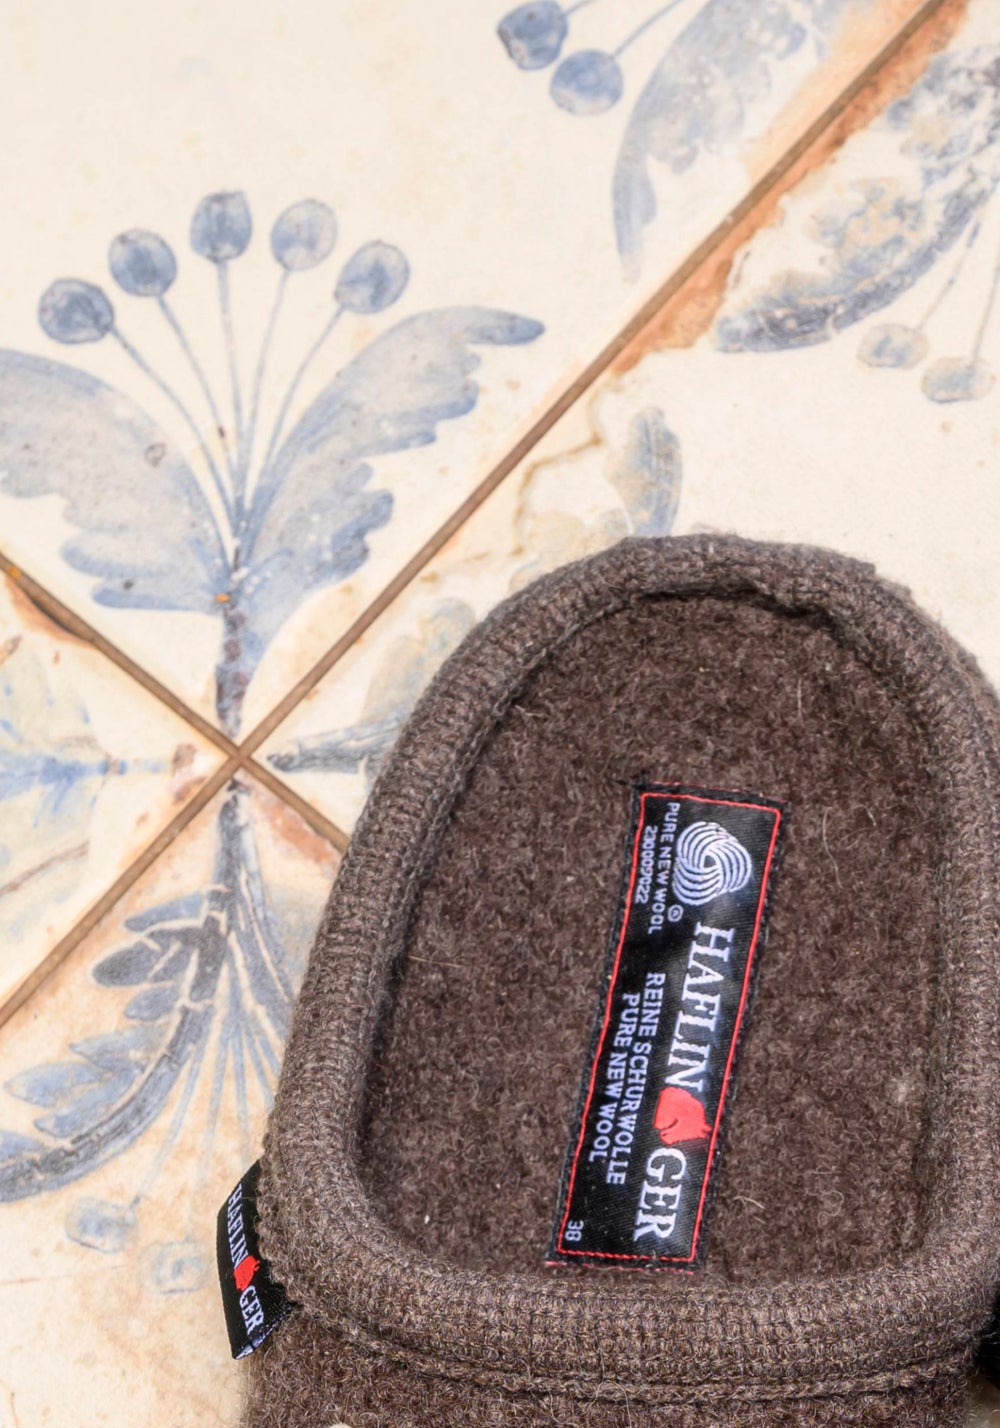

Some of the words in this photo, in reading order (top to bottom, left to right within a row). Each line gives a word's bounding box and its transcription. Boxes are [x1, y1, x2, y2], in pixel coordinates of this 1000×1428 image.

[659, 802, 680, 842] PURE
[657, 846, 672, 885] NEW
[647, 887, 667, 934] WOOL
[613, 993, 640, 1047] PURE
[638, 972, 666, 1037] REINE
[605, 1051, 628, 1099] NEW
[588, 1102, 617, 1162] WOOL
[564, 1219, 585, 1243] 38
